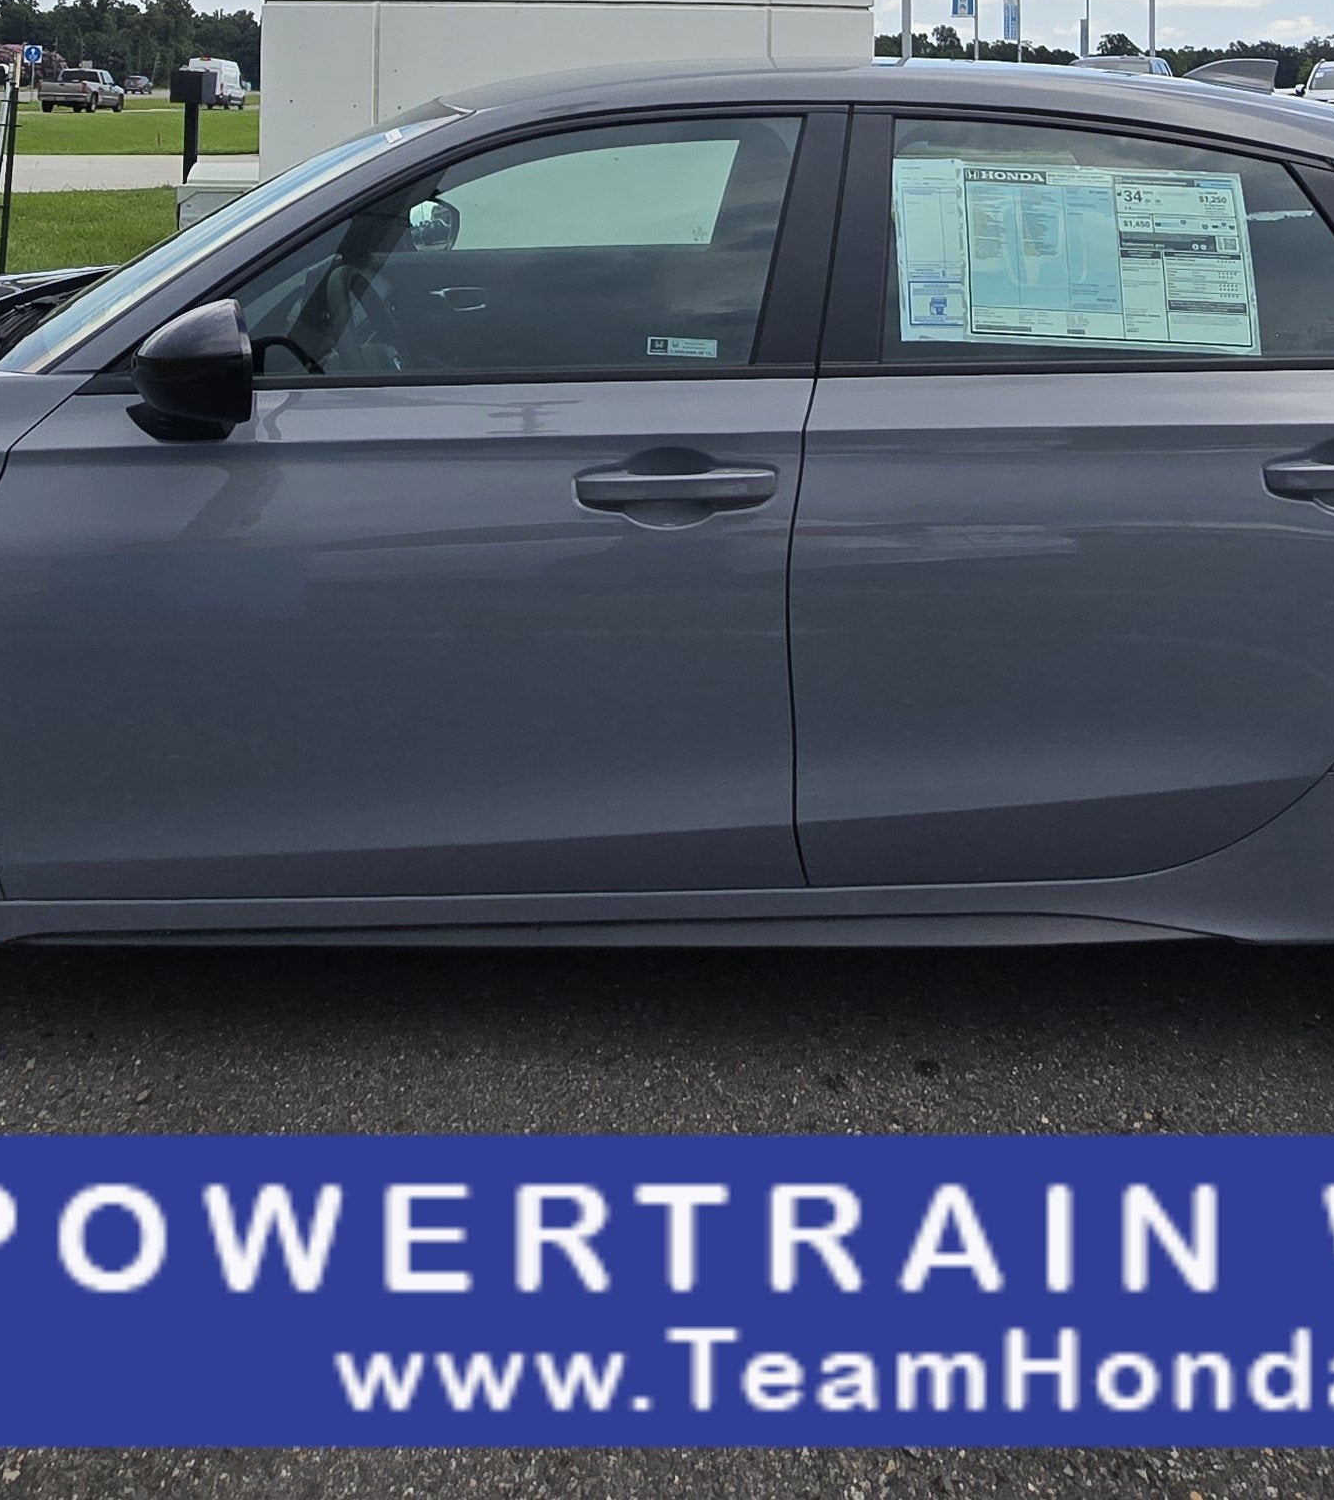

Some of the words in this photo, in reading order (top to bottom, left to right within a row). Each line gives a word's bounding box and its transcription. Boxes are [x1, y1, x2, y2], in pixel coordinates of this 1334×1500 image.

[981, 170, 1045, 182] HONDA
[1124, 190, 1142, 203] 34
[1198, 195, 1227, 204] $1,250
